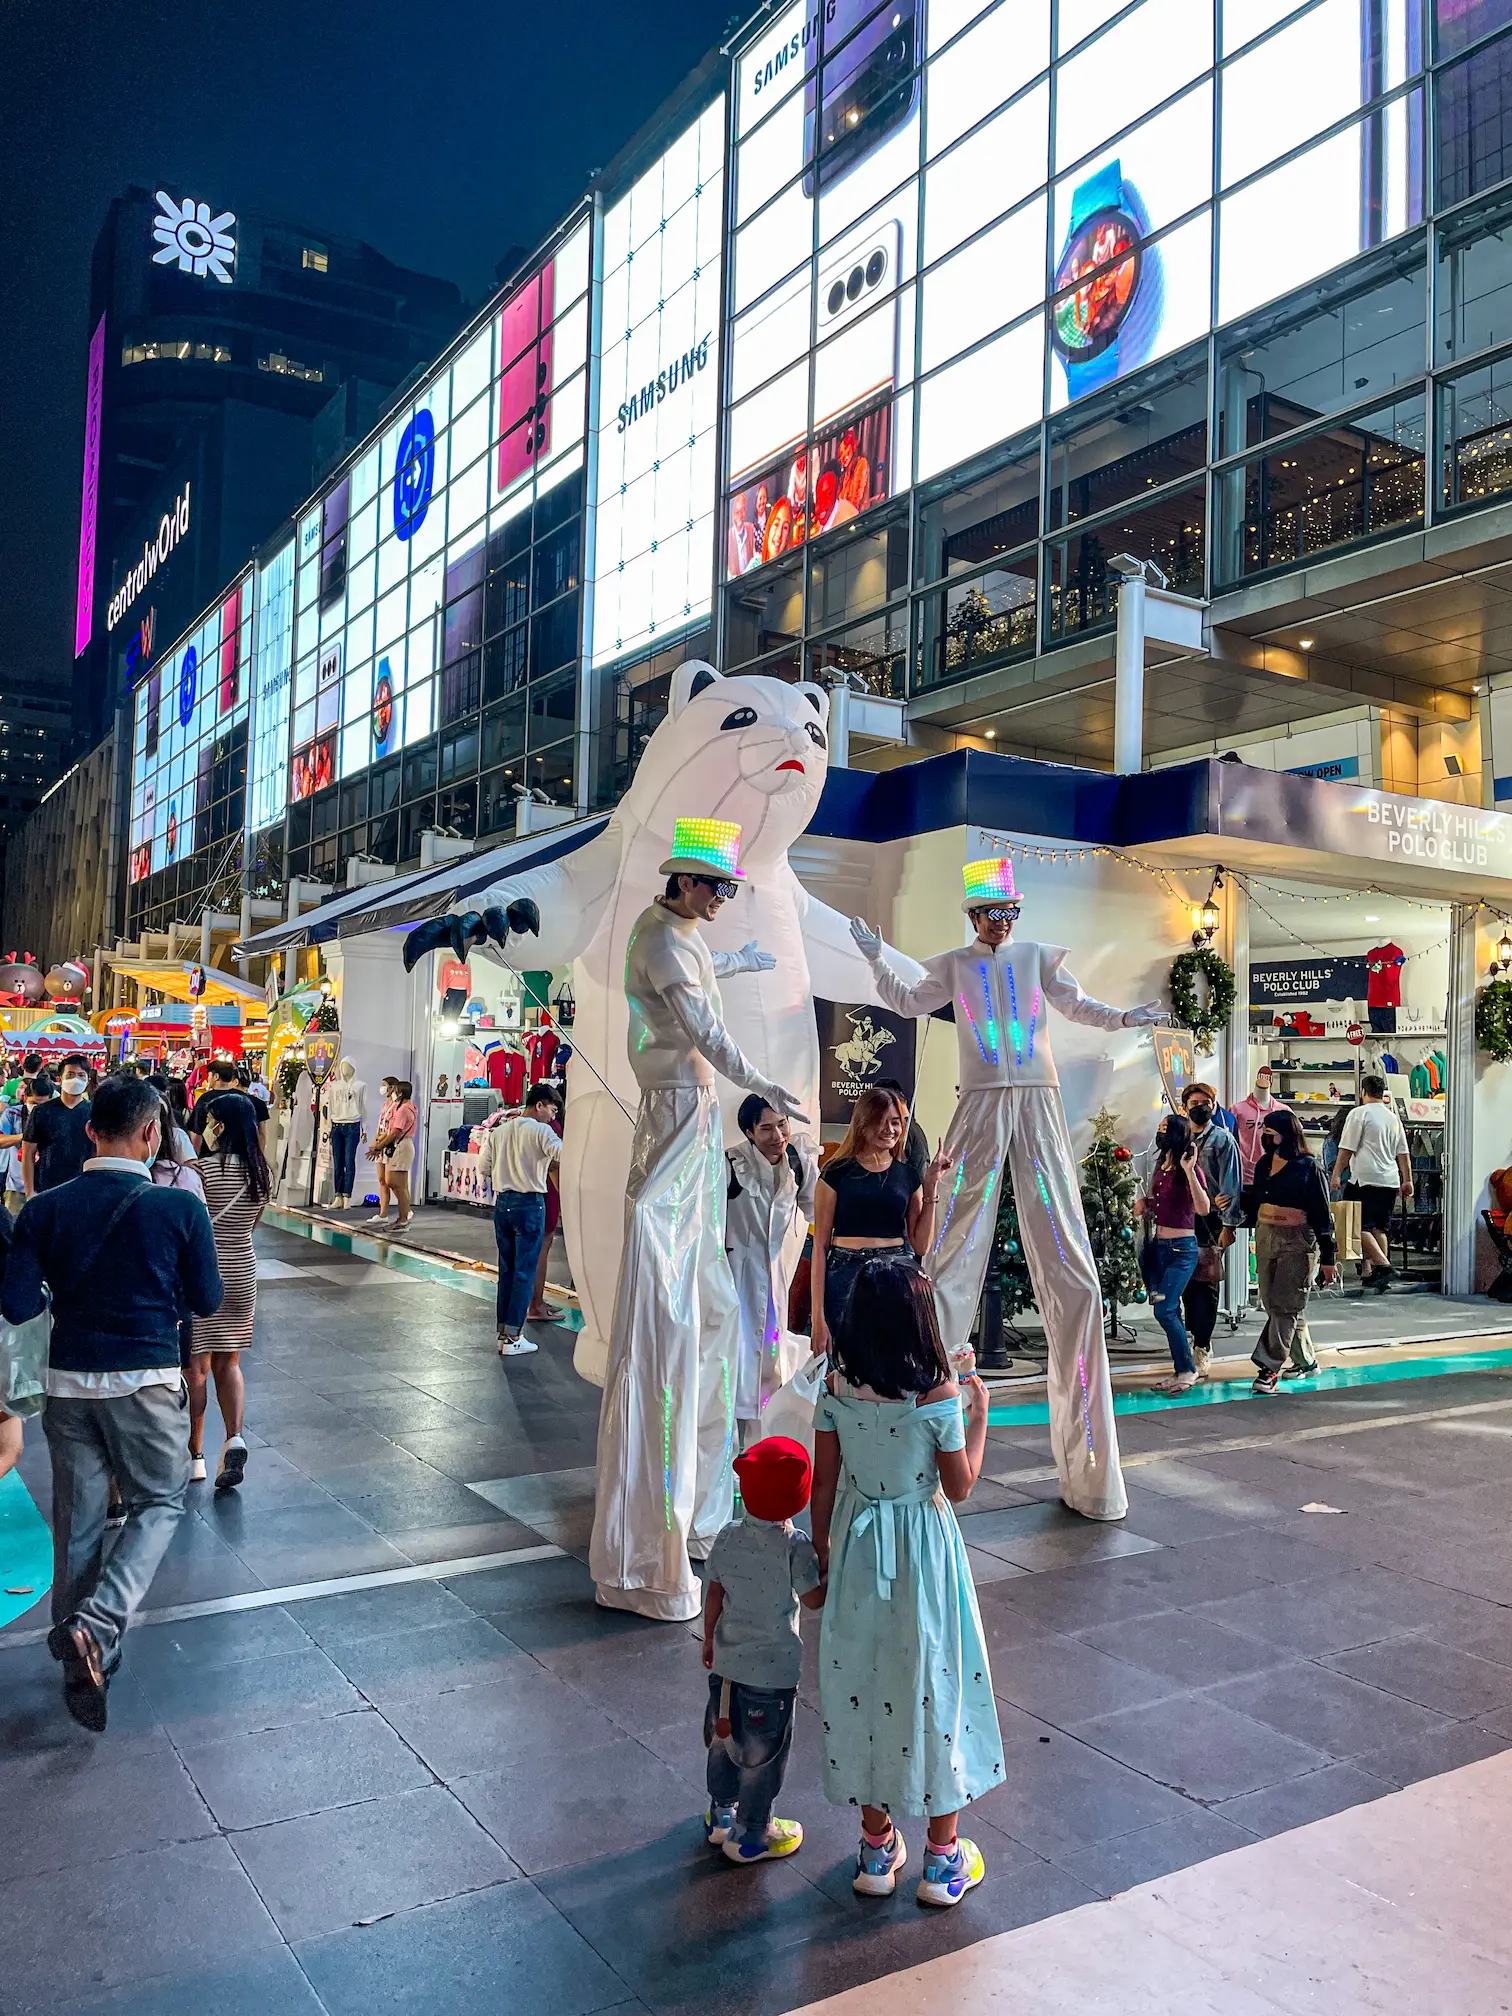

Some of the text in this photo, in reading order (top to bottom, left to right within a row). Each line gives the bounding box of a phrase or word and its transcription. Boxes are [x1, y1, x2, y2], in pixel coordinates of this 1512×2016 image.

[617, 336, 710, 434] SAMSUNG
[1317, 763, 1342, 778] OPEN
[1368, 801, 1452, 835] BEVERLY
[1388, 830, 1488, 866] POLO CLUB
[1252, 971, 1297, 983] BEVERLY
[1263, 980, 1320, 992] POLO CLUB
[831, 1081, 864, 1090] BEVERLY
[838, 1088, 858, 1097] POLO
